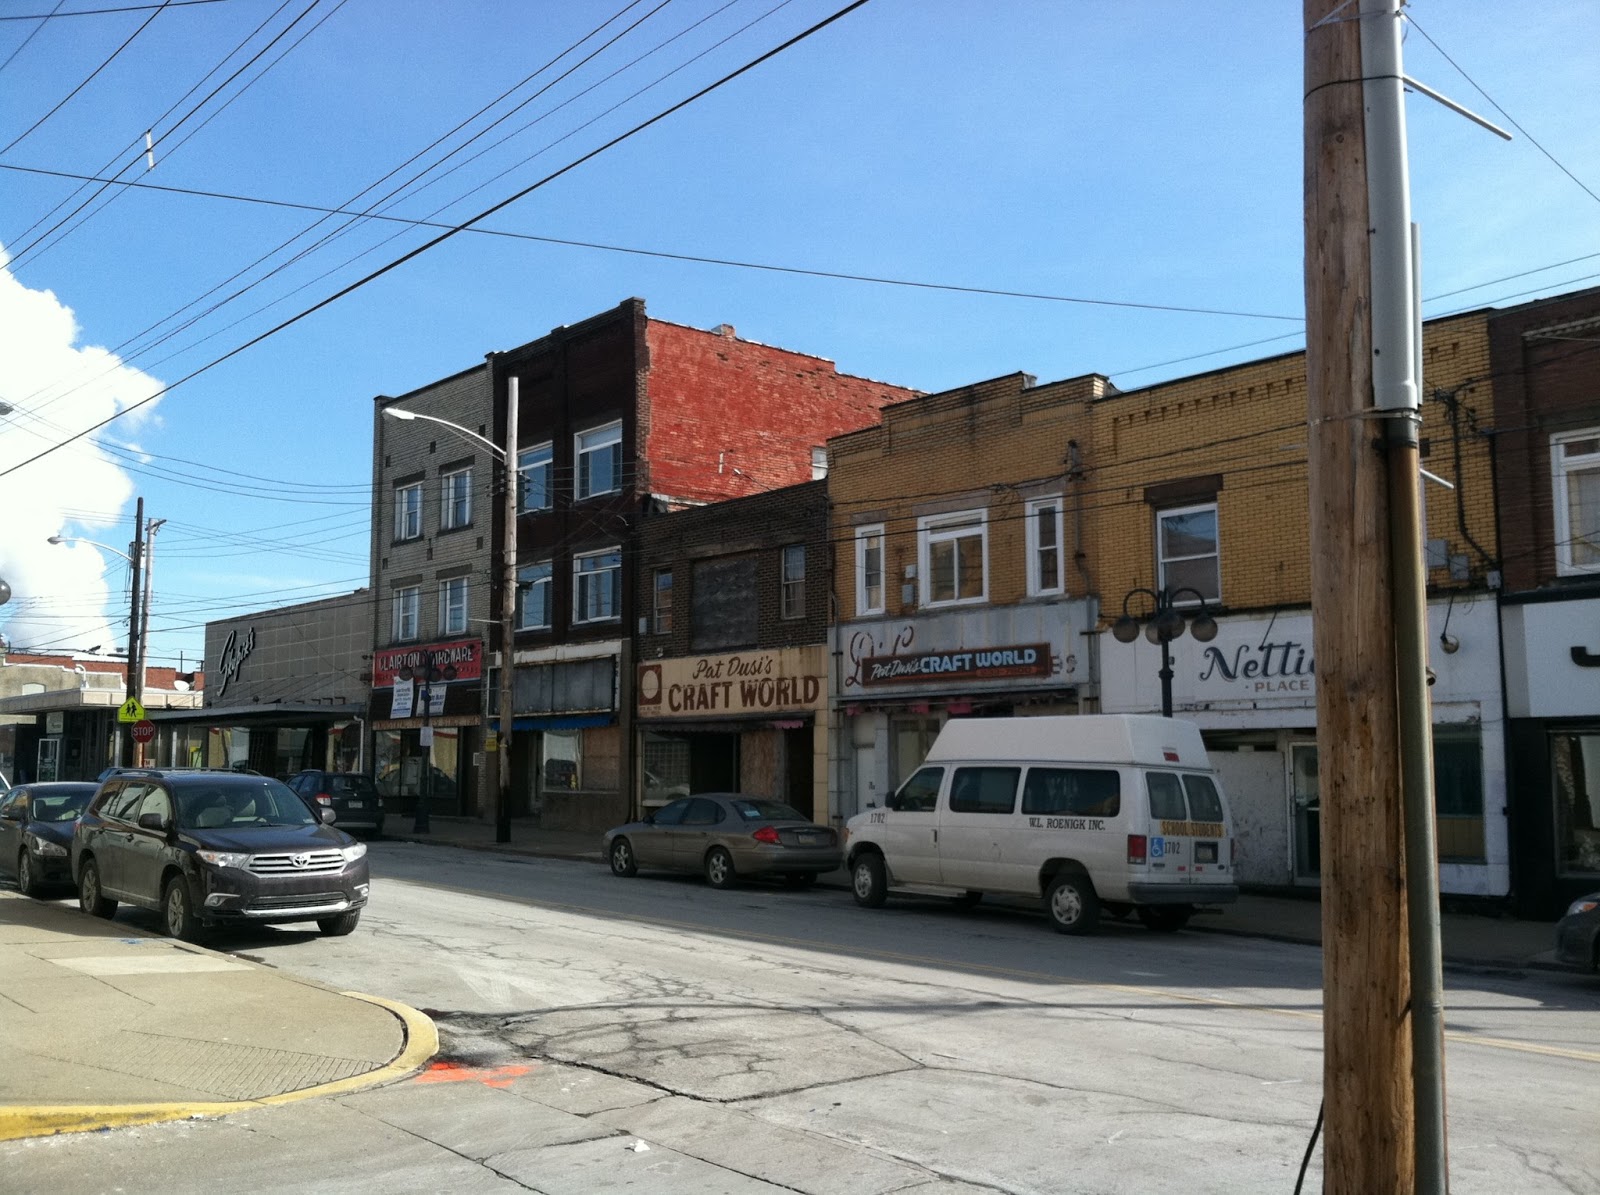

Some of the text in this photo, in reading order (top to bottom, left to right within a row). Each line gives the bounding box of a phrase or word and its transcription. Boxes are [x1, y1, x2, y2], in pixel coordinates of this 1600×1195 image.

[378, 646, 474, 671] CLAIRTON ARDWARE
[870, 663, 892, 680] Pat
[890, 658, 920, 677] Dusi's
[919, 653, 972, 674] CRAFT
[975, 649, 1037, 668] WORLD
[692, 655, 773, 679] Pat Dusi's
[668, 675, 820, 712] CRAFT WORLD
[1254, 680, 1310, 692] PLACE
[133, 726, 154, 737] STOP
[870, 813, 886, 824] 1702
[1046, 818, 1086, 830] ROENIGK
[1088, 819, 1106, 831] INC.
[1161, 821, 1222, 838] SCHOOL STUDENTS
[1164, 841, 1181, 854] 1702
